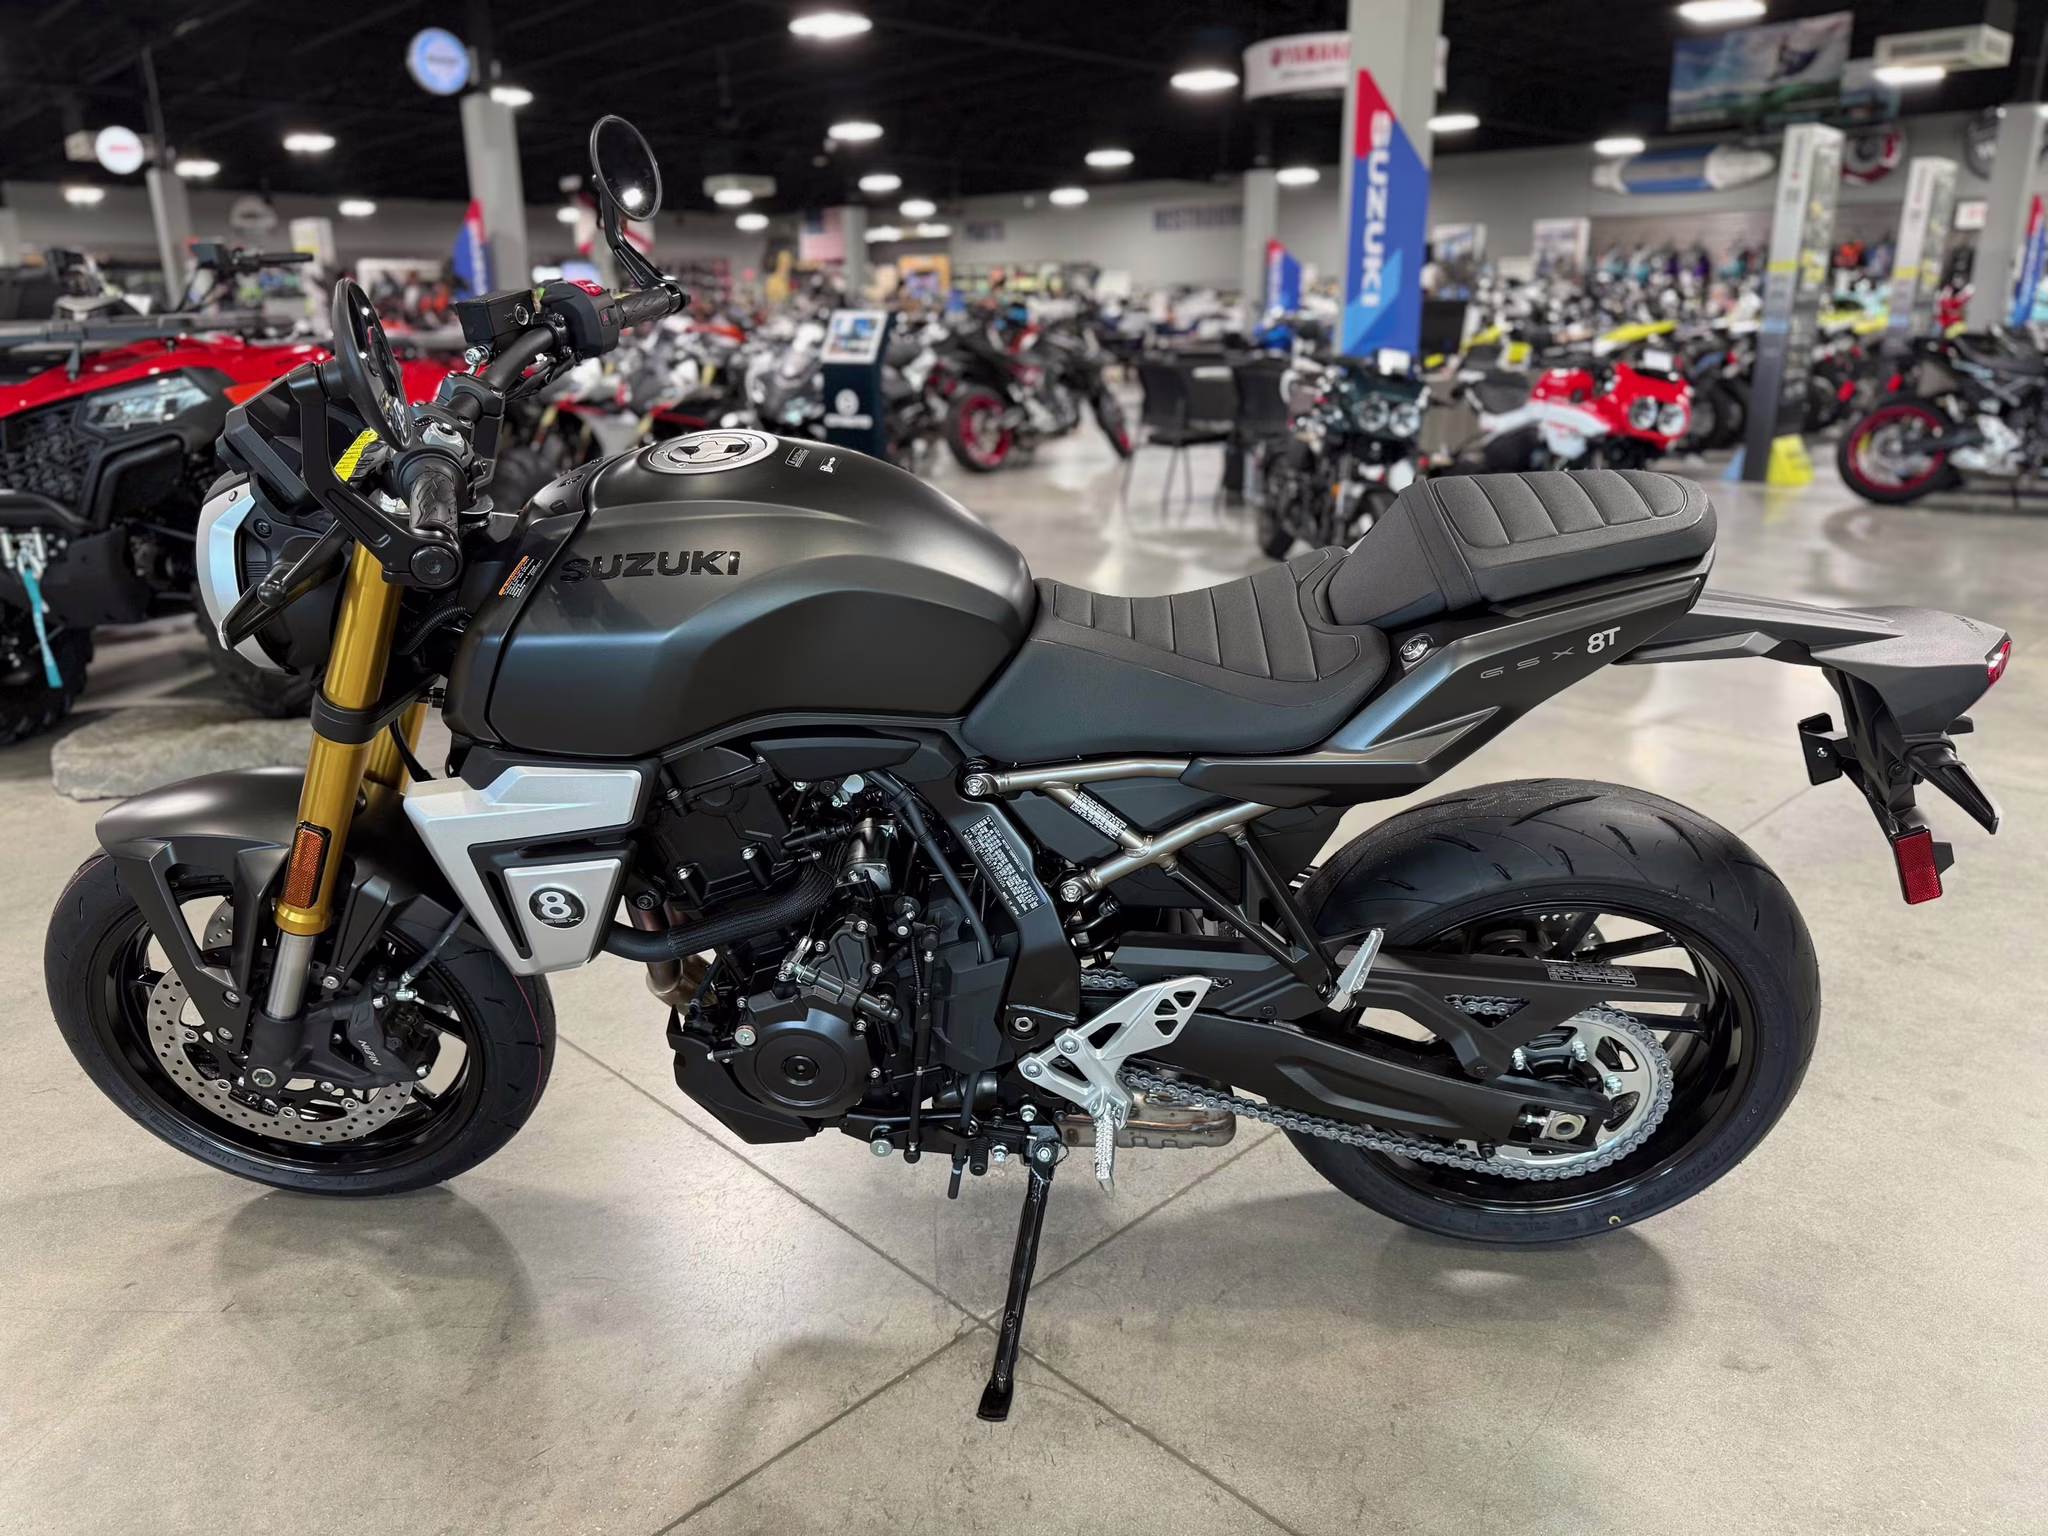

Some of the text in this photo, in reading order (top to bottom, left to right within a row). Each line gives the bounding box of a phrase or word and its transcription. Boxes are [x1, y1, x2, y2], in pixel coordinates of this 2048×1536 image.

[1362, 110, 1392, 307] SUZUKI
[560, 551, 741, 583] SUZUKI
[1587, 626, 1621, 654] 8T
[538, 891, 572, 919] 8
